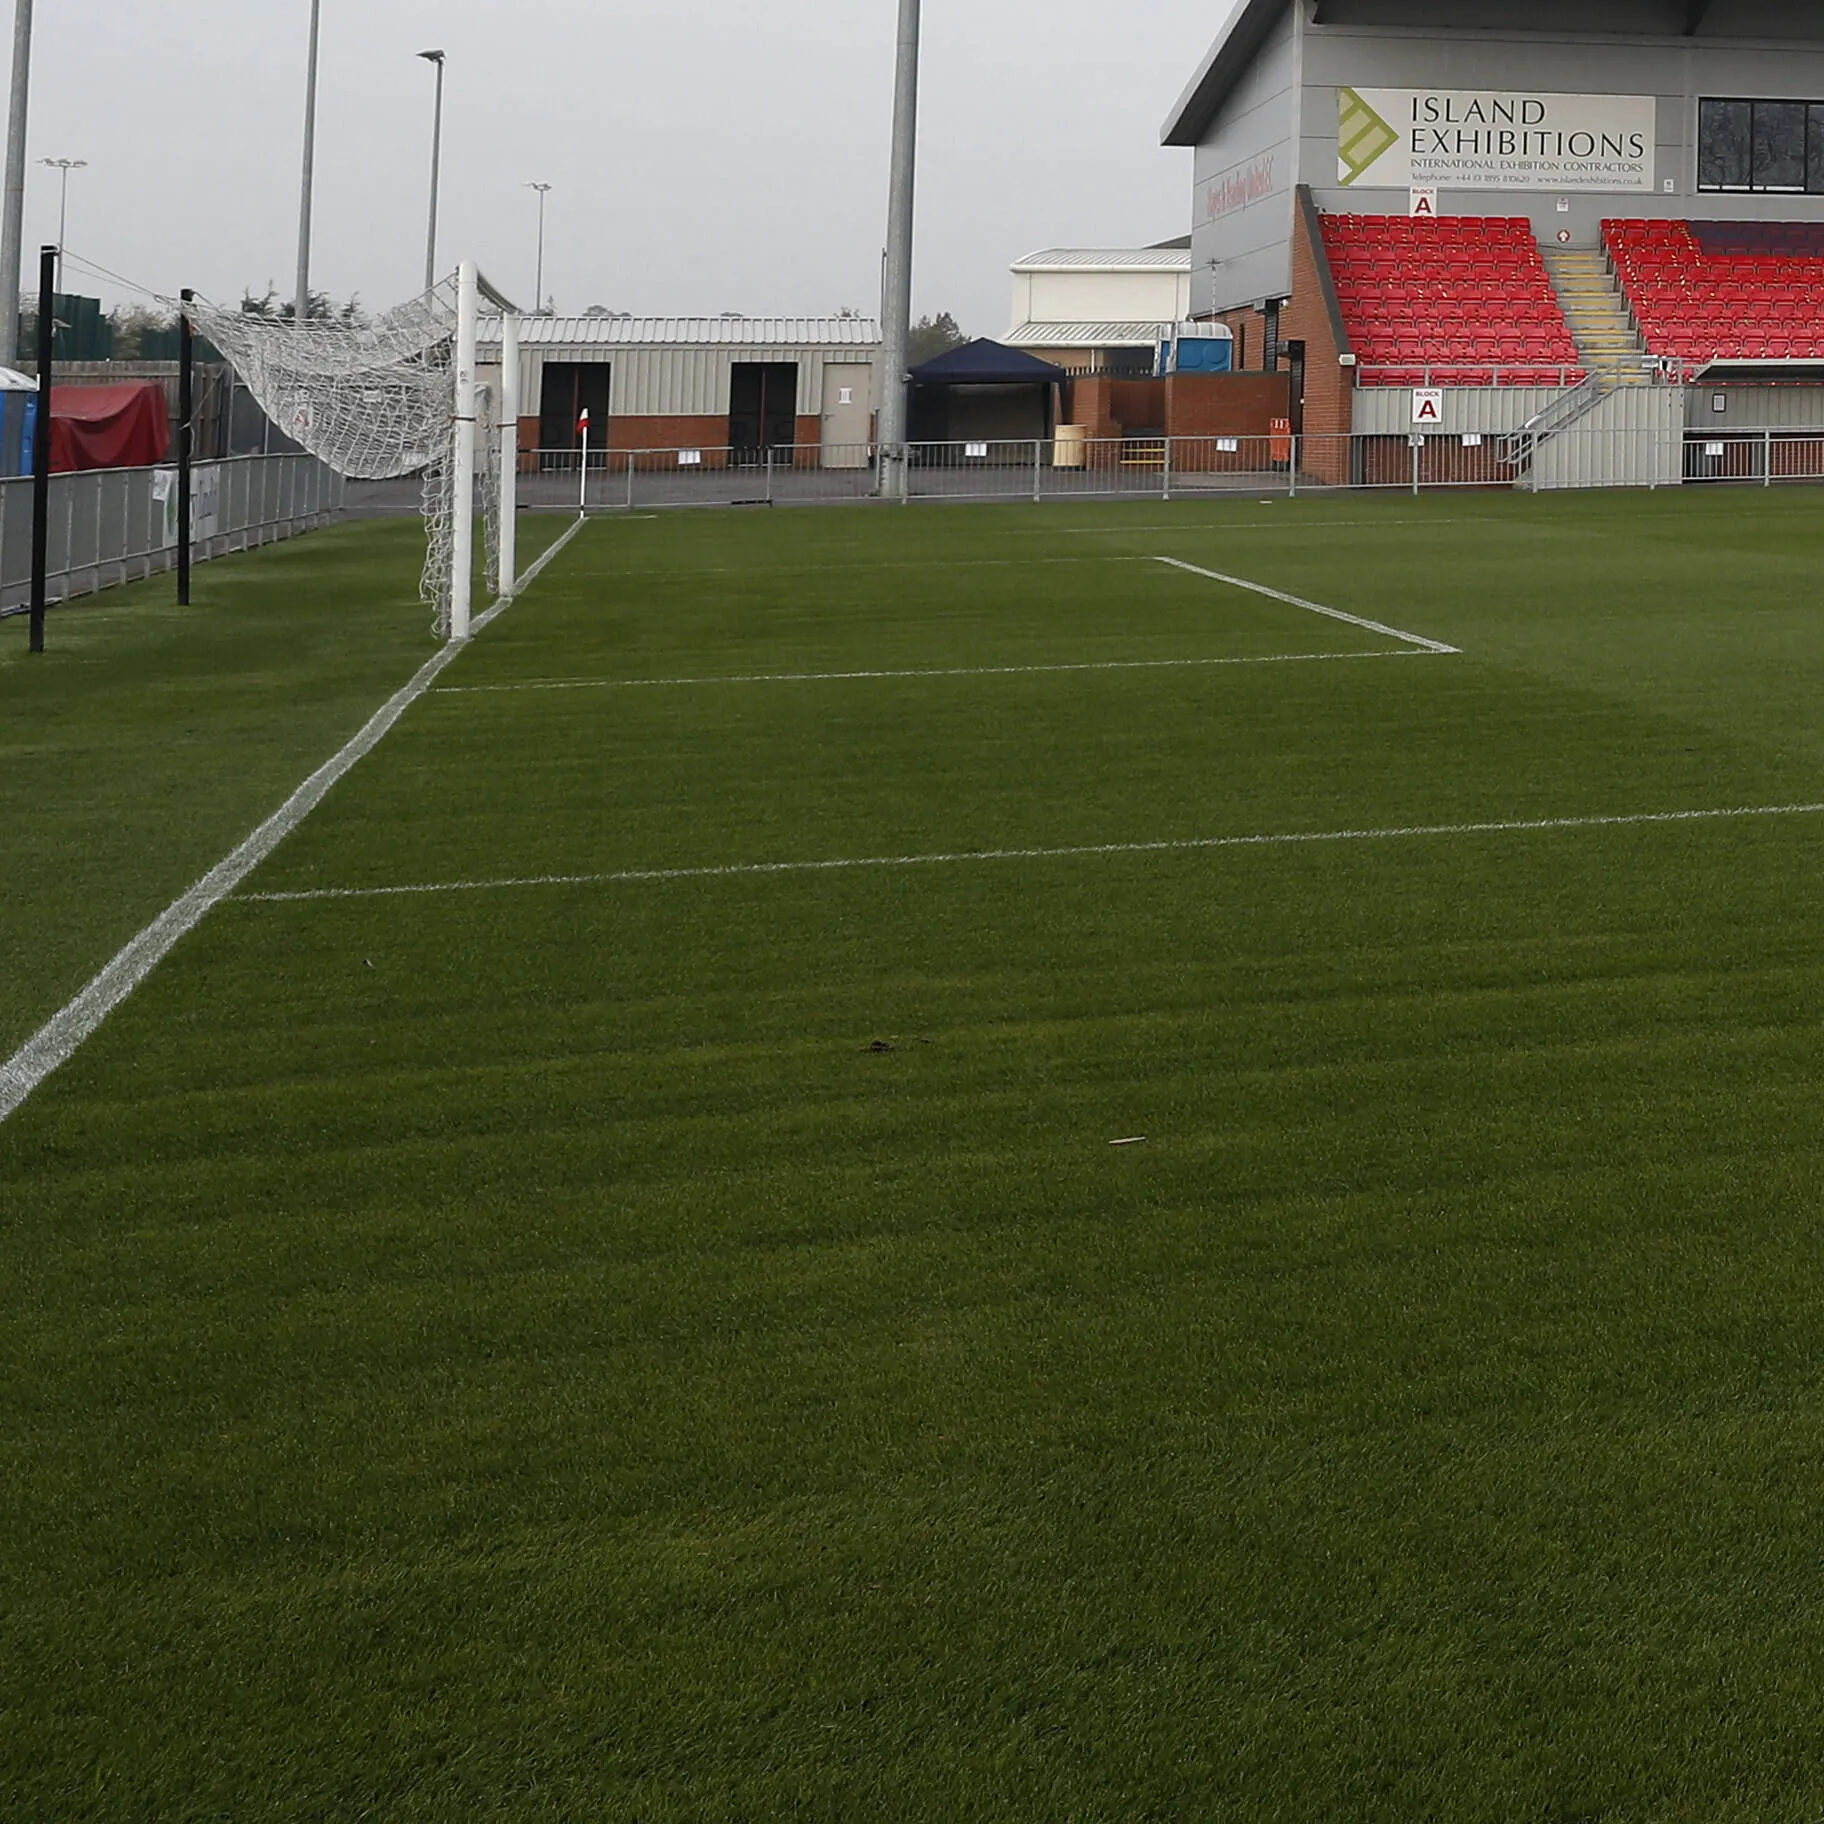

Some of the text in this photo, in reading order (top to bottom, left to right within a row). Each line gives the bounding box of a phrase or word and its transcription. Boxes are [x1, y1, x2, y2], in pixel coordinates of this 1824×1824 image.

[1410, 96, 1546, 125] ISLAND
[1410, 128, 1645, 158] EXHIBITIONS
[1410, 158, 1644, 173] INTERNATIONAL EXHIBITION CONTRACTORS
[1414, 197, 1432, 214] A
[1418, 399, 1437, 418] A
